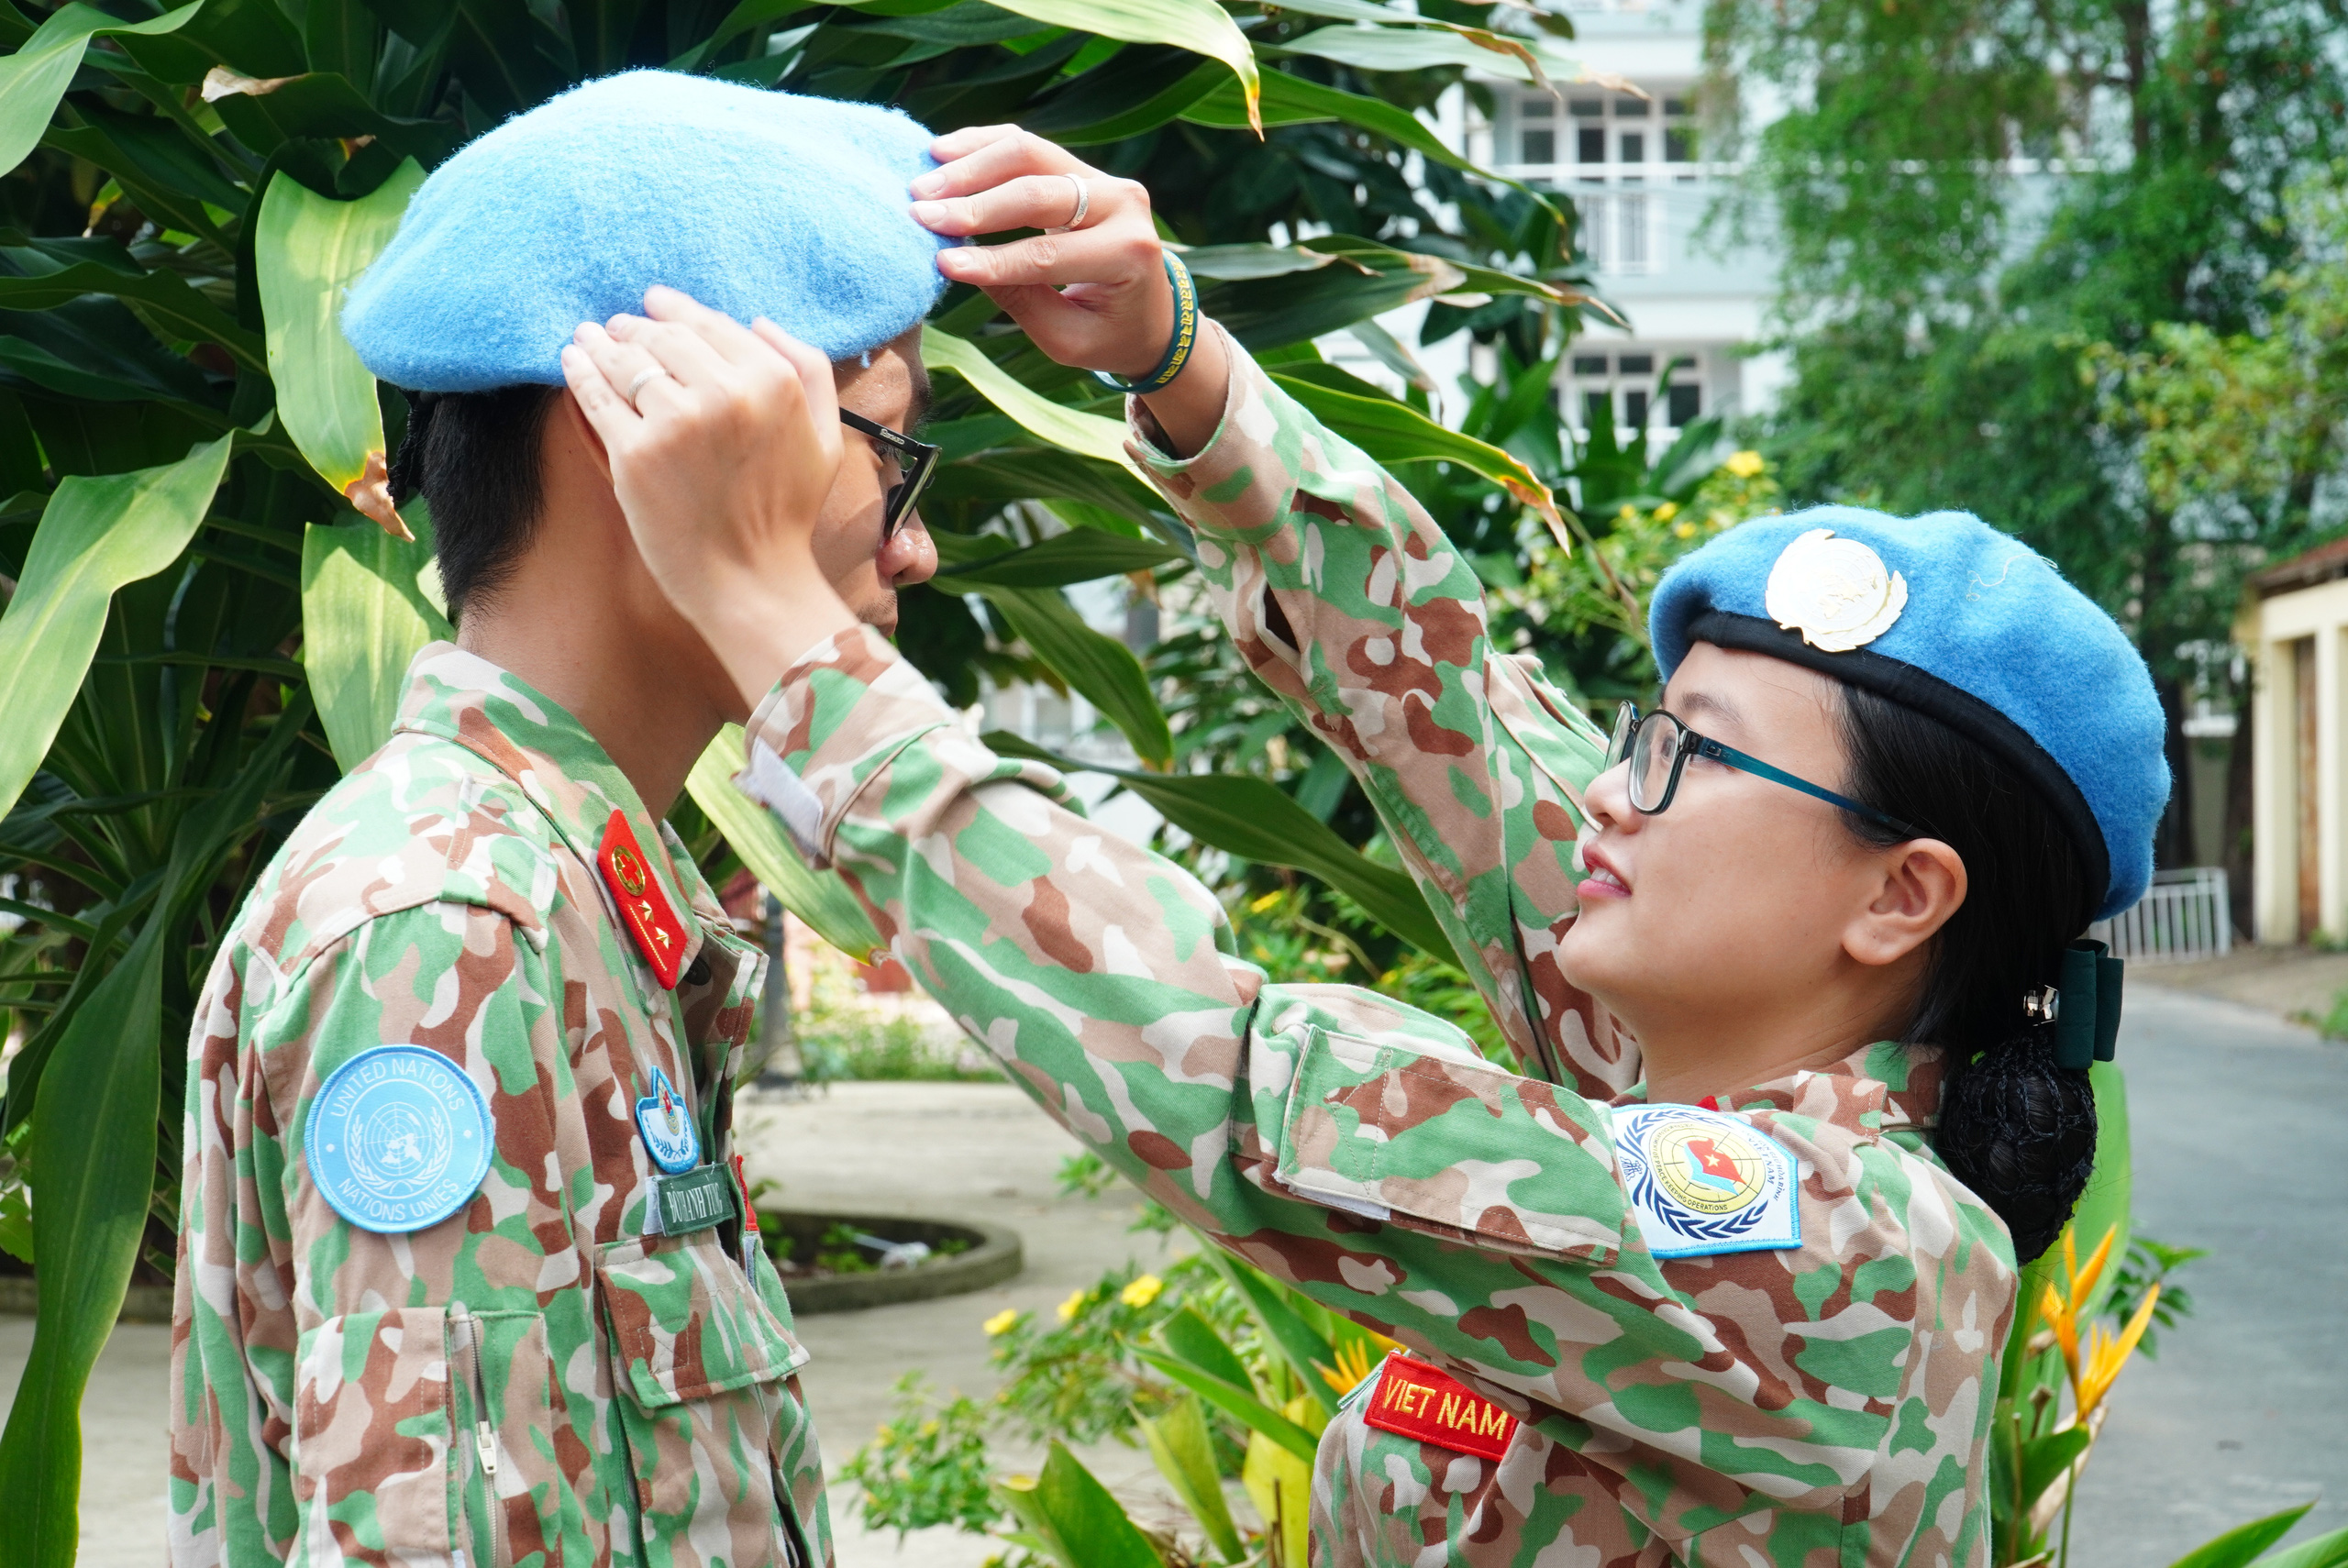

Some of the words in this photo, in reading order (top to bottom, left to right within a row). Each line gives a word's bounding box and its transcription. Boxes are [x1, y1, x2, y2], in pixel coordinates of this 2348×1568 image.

[330, 1062, 386, 1117] UNITED
[392, 1058, 464, 1110] NATIONS
[1655, 1160, 1666, 1181] PEACE
[1688, 1199, 1728, 1210] OPERATIONS
[1766, 1160, 1775, 1185] NAM
[338, 1177, 405, 1220] NATIONS
[410, 1178, 459, 1217] UNIES
[1382, 1375, 1436, 1418] VIET
[1435, 1392, 1508, 1440] NAM
